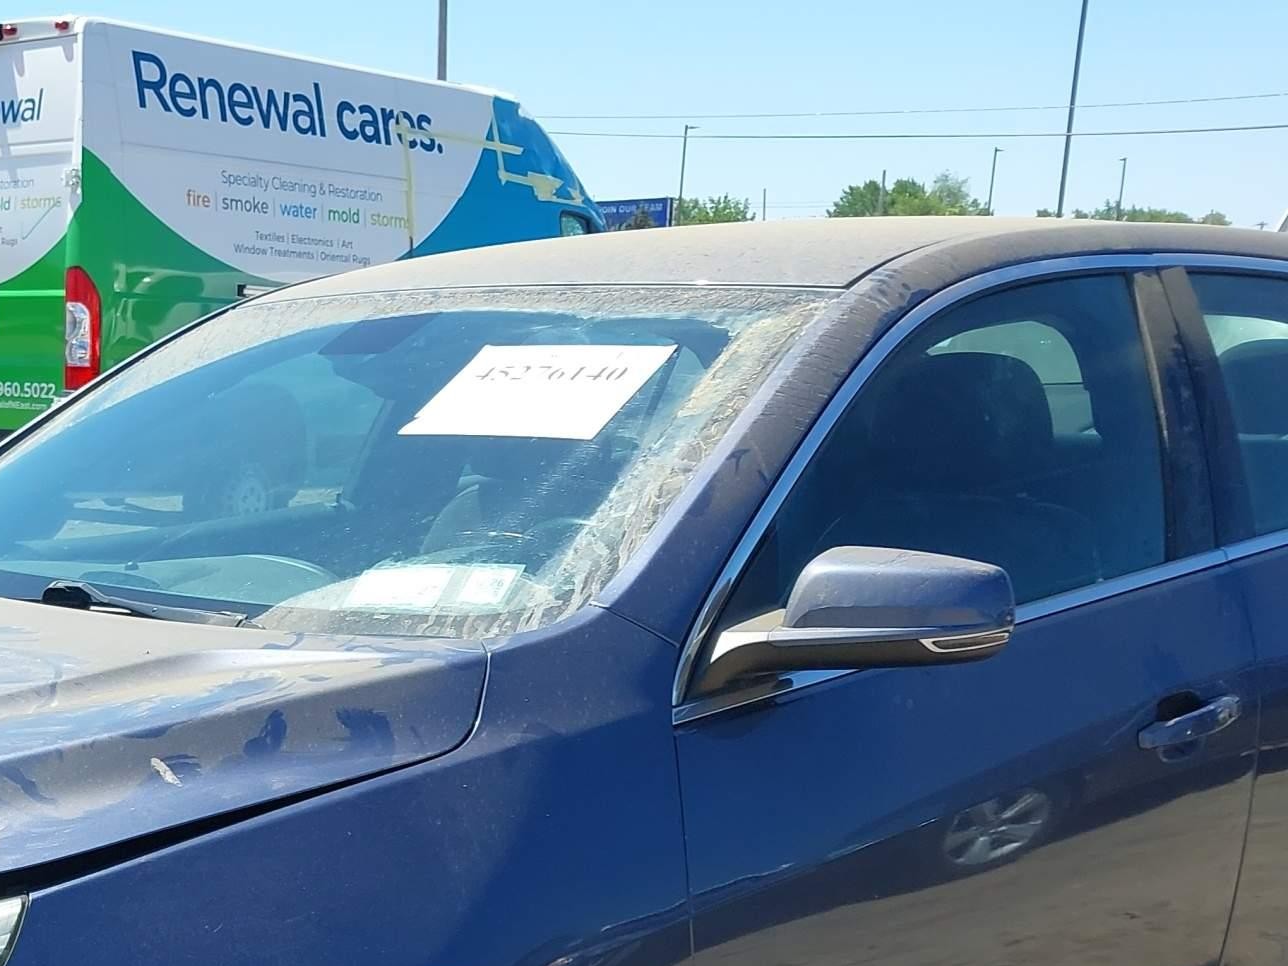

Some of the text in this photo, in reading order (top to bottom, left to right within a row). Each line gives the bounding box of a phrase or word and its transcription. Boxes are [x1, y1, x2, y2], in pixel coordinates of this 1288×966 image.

[131, 50, 444, 154] Renewal cares.
[220, 170, 383, 202] Specialty Cleaning & Restoration
[19, 195, 62, 209] storms
[186, 189, 211, 208] fire
[222, 195, 269, 215] smoke
[280, 202, 318, 219] water
[328, 206, 360, 224] mold
[255, 231, 353, 249] Textiles Electronics Art
[233, 243, 371, 266] Window Treatments Oriental Rugs
